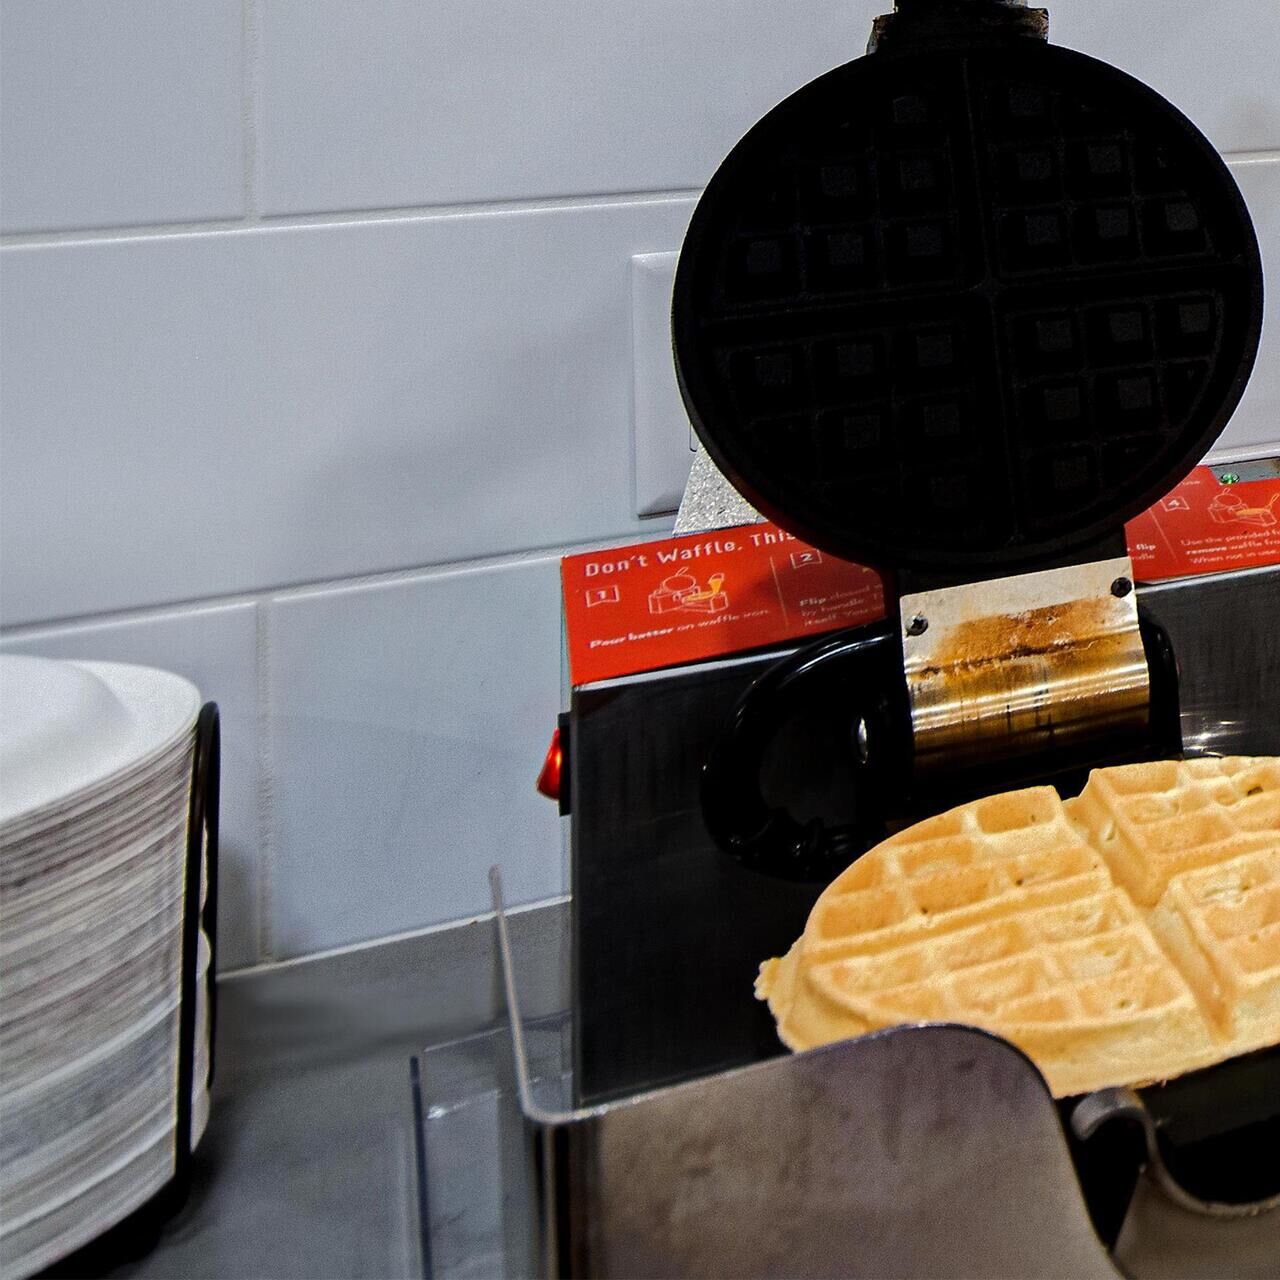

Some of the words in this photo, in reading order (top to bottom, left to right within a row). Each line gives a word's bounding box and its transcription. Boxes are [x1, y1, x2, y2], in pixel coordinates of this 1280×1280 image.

[585, 554, 648, 577] Don't
[657, 541, 742, 564] Waffle.
[750, 528, 797, 547] This
[589, 635, 626, 649] Pour
[628, 628, 674, 641] batter
